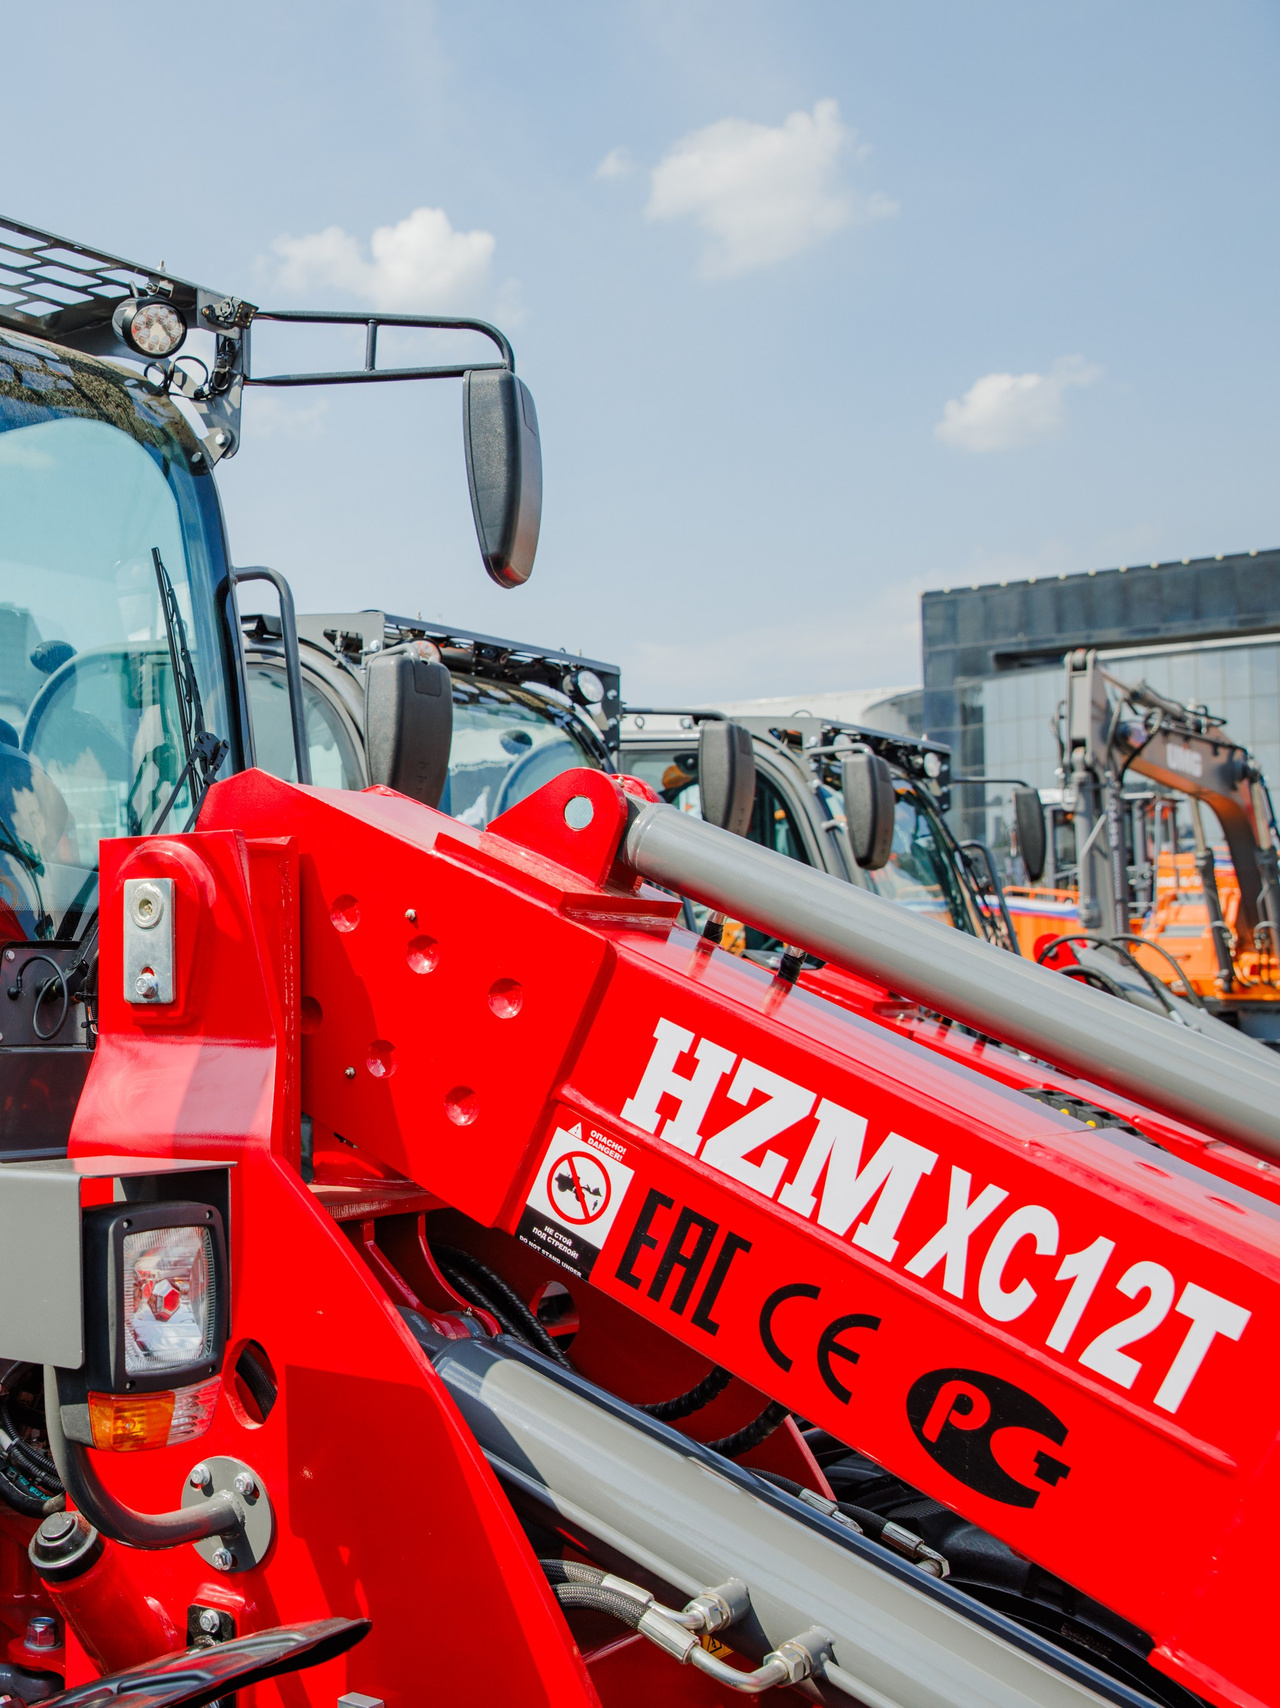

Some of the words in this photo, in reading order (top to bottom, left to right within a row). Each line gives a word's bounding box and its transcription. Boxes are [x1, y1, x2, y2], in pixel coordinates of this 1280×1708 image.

[587, 1137, 623, 1162] DANGER!
[590, 1130, 627, 1155] ОПАСНО!
[620, 1017, 939, 1263] HZM
[903, 1165, 1252, 1414] XC12T
[532, 1227, 548, 1241] ПОД
[547, 1236, 579, 1260] СТРЕЛОЙ!
[544, 1225, 555, 1236] НЕ
[554, 1232, 573, 1247] СТОЙ
[519, 1235, 528, 1244] DO
[528, 1240, 541, 1252] NOT
[541, 1249, 561, 1265] STAND
[561, 1261, 582, 1277] UNDER
